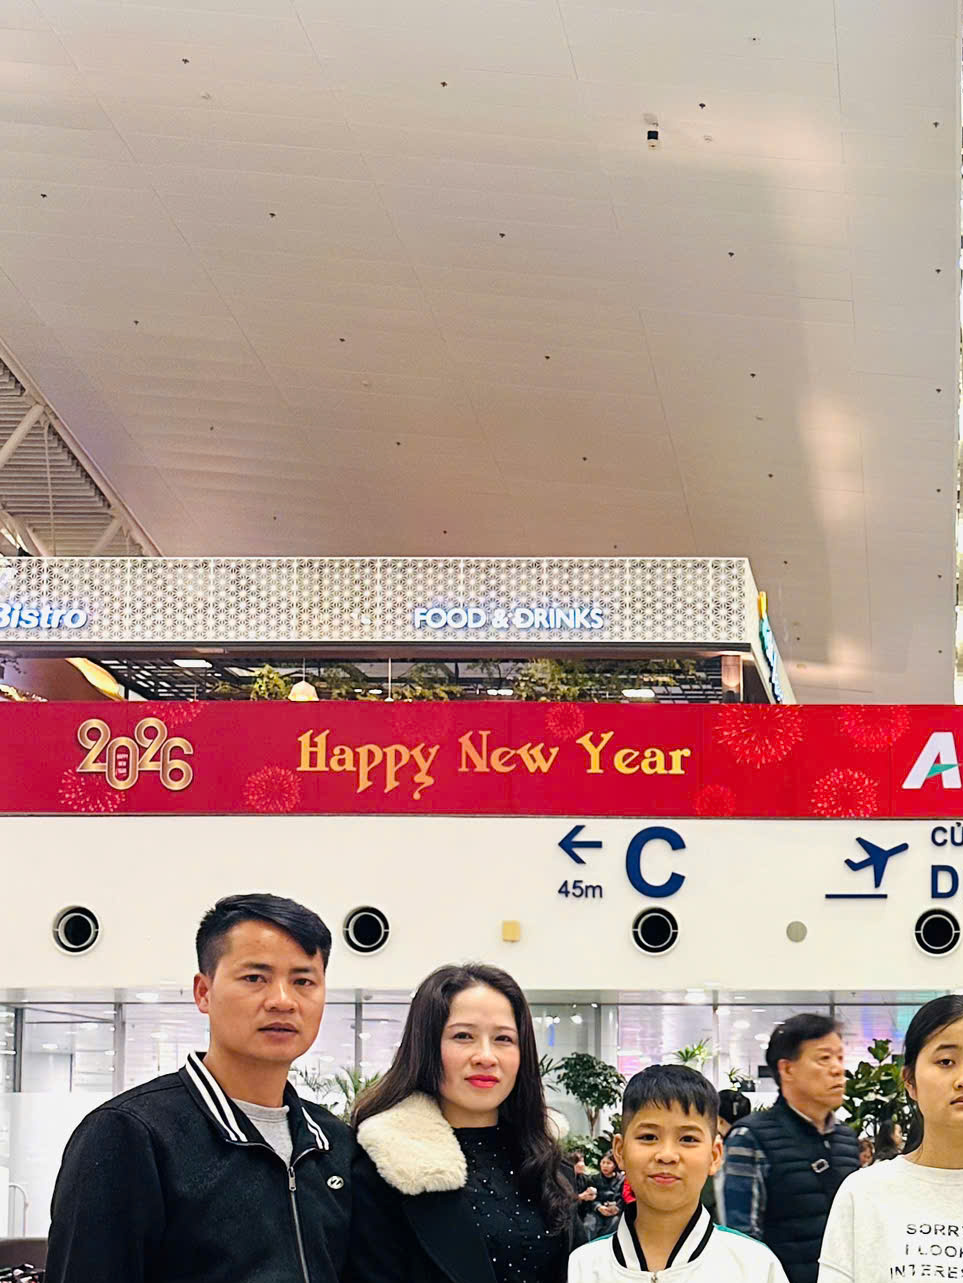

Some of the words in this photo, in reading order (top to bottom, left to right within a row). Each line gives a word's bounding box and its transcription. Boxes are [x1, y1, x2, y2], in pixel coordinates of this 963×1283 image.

[414, 608, 487, 628] FOOD
[492, 608, 510, 629] &
[514, 608, 604, 629] DRINKS
[76, 717, 194, 791] 2026
[297, 729, 439, 799] Happy
[458, 730, 559, 774] New
[576, 730, 691, 776] Year
[558, 880, 604, 899] 45m
[625, 826, 687, 899] C
